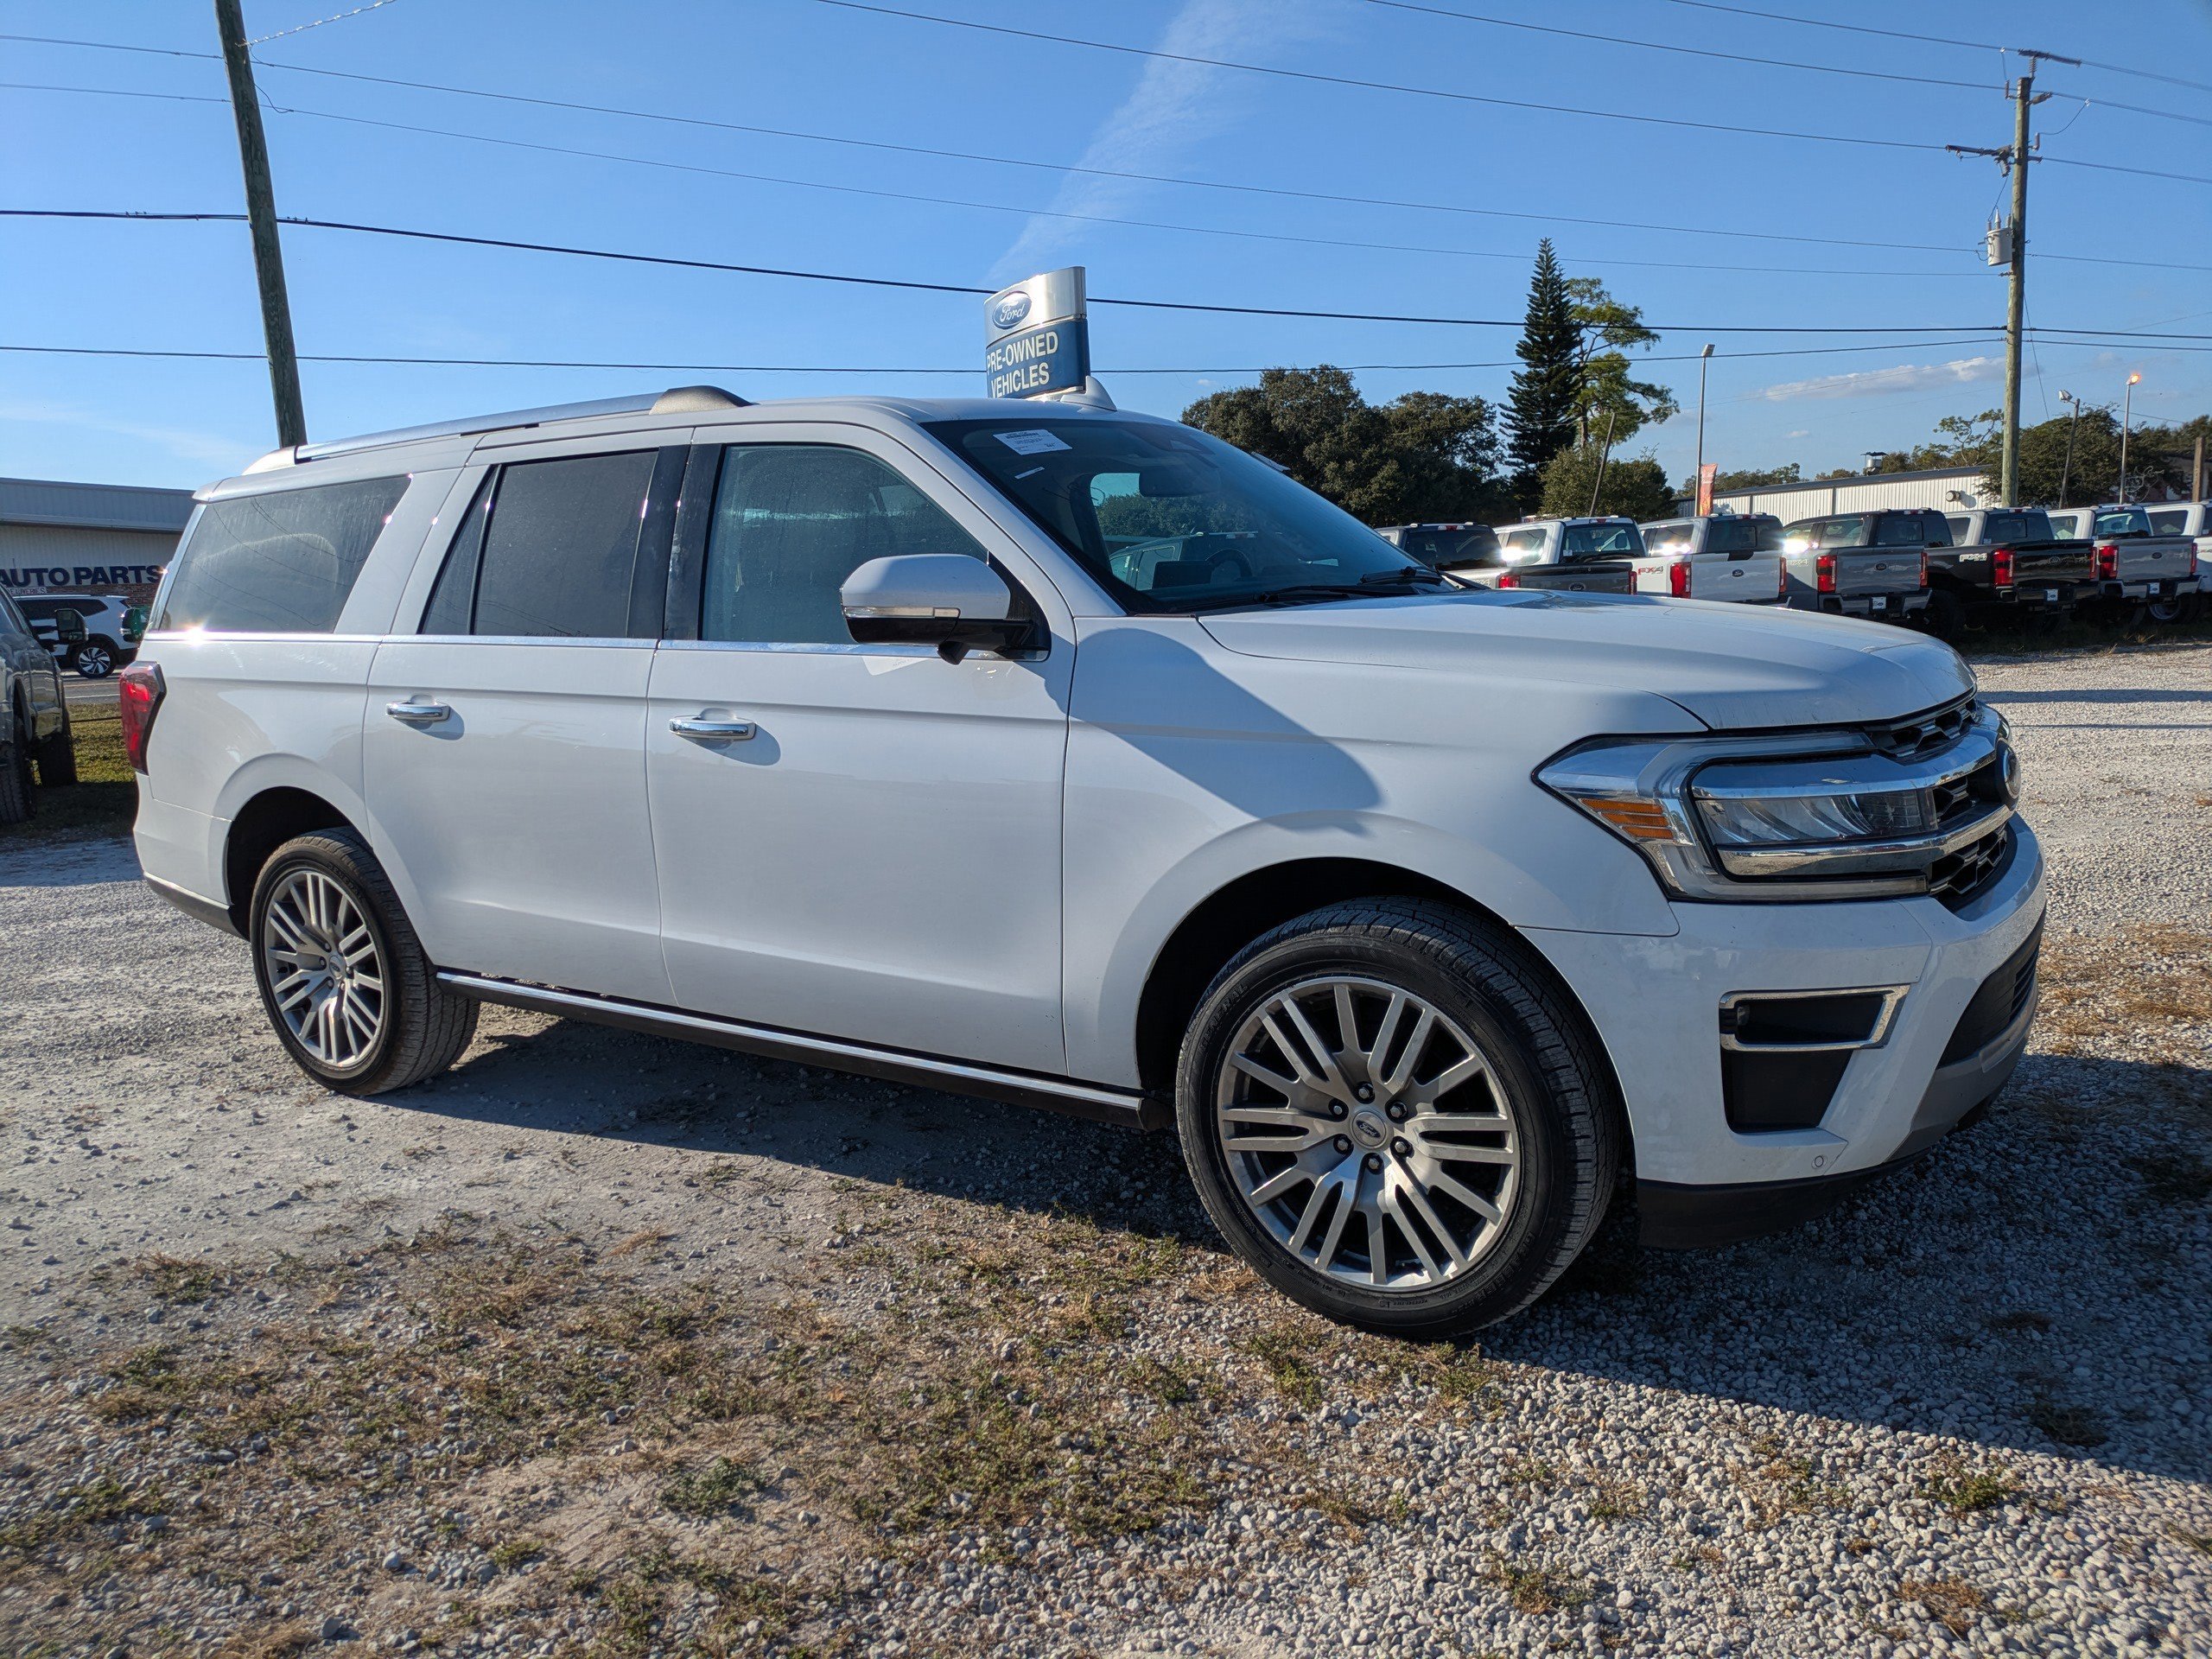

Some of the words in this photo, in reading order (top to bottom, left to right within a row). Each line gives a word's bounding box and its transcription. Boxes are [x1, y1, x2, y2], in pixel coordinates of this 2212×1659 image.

[1000, 303, 1026, 322] Ford
[987, 331, 1058, 375] PRE-OWNED
[991, 362, 1050, 398] VEHICLES
[0, 568, 69, 588] AUTO
[73, 565, 162, 585] PARTS
[1637, 566, 1663, 575] FX4
[1359, 1122, 1377, 1138] Ford
